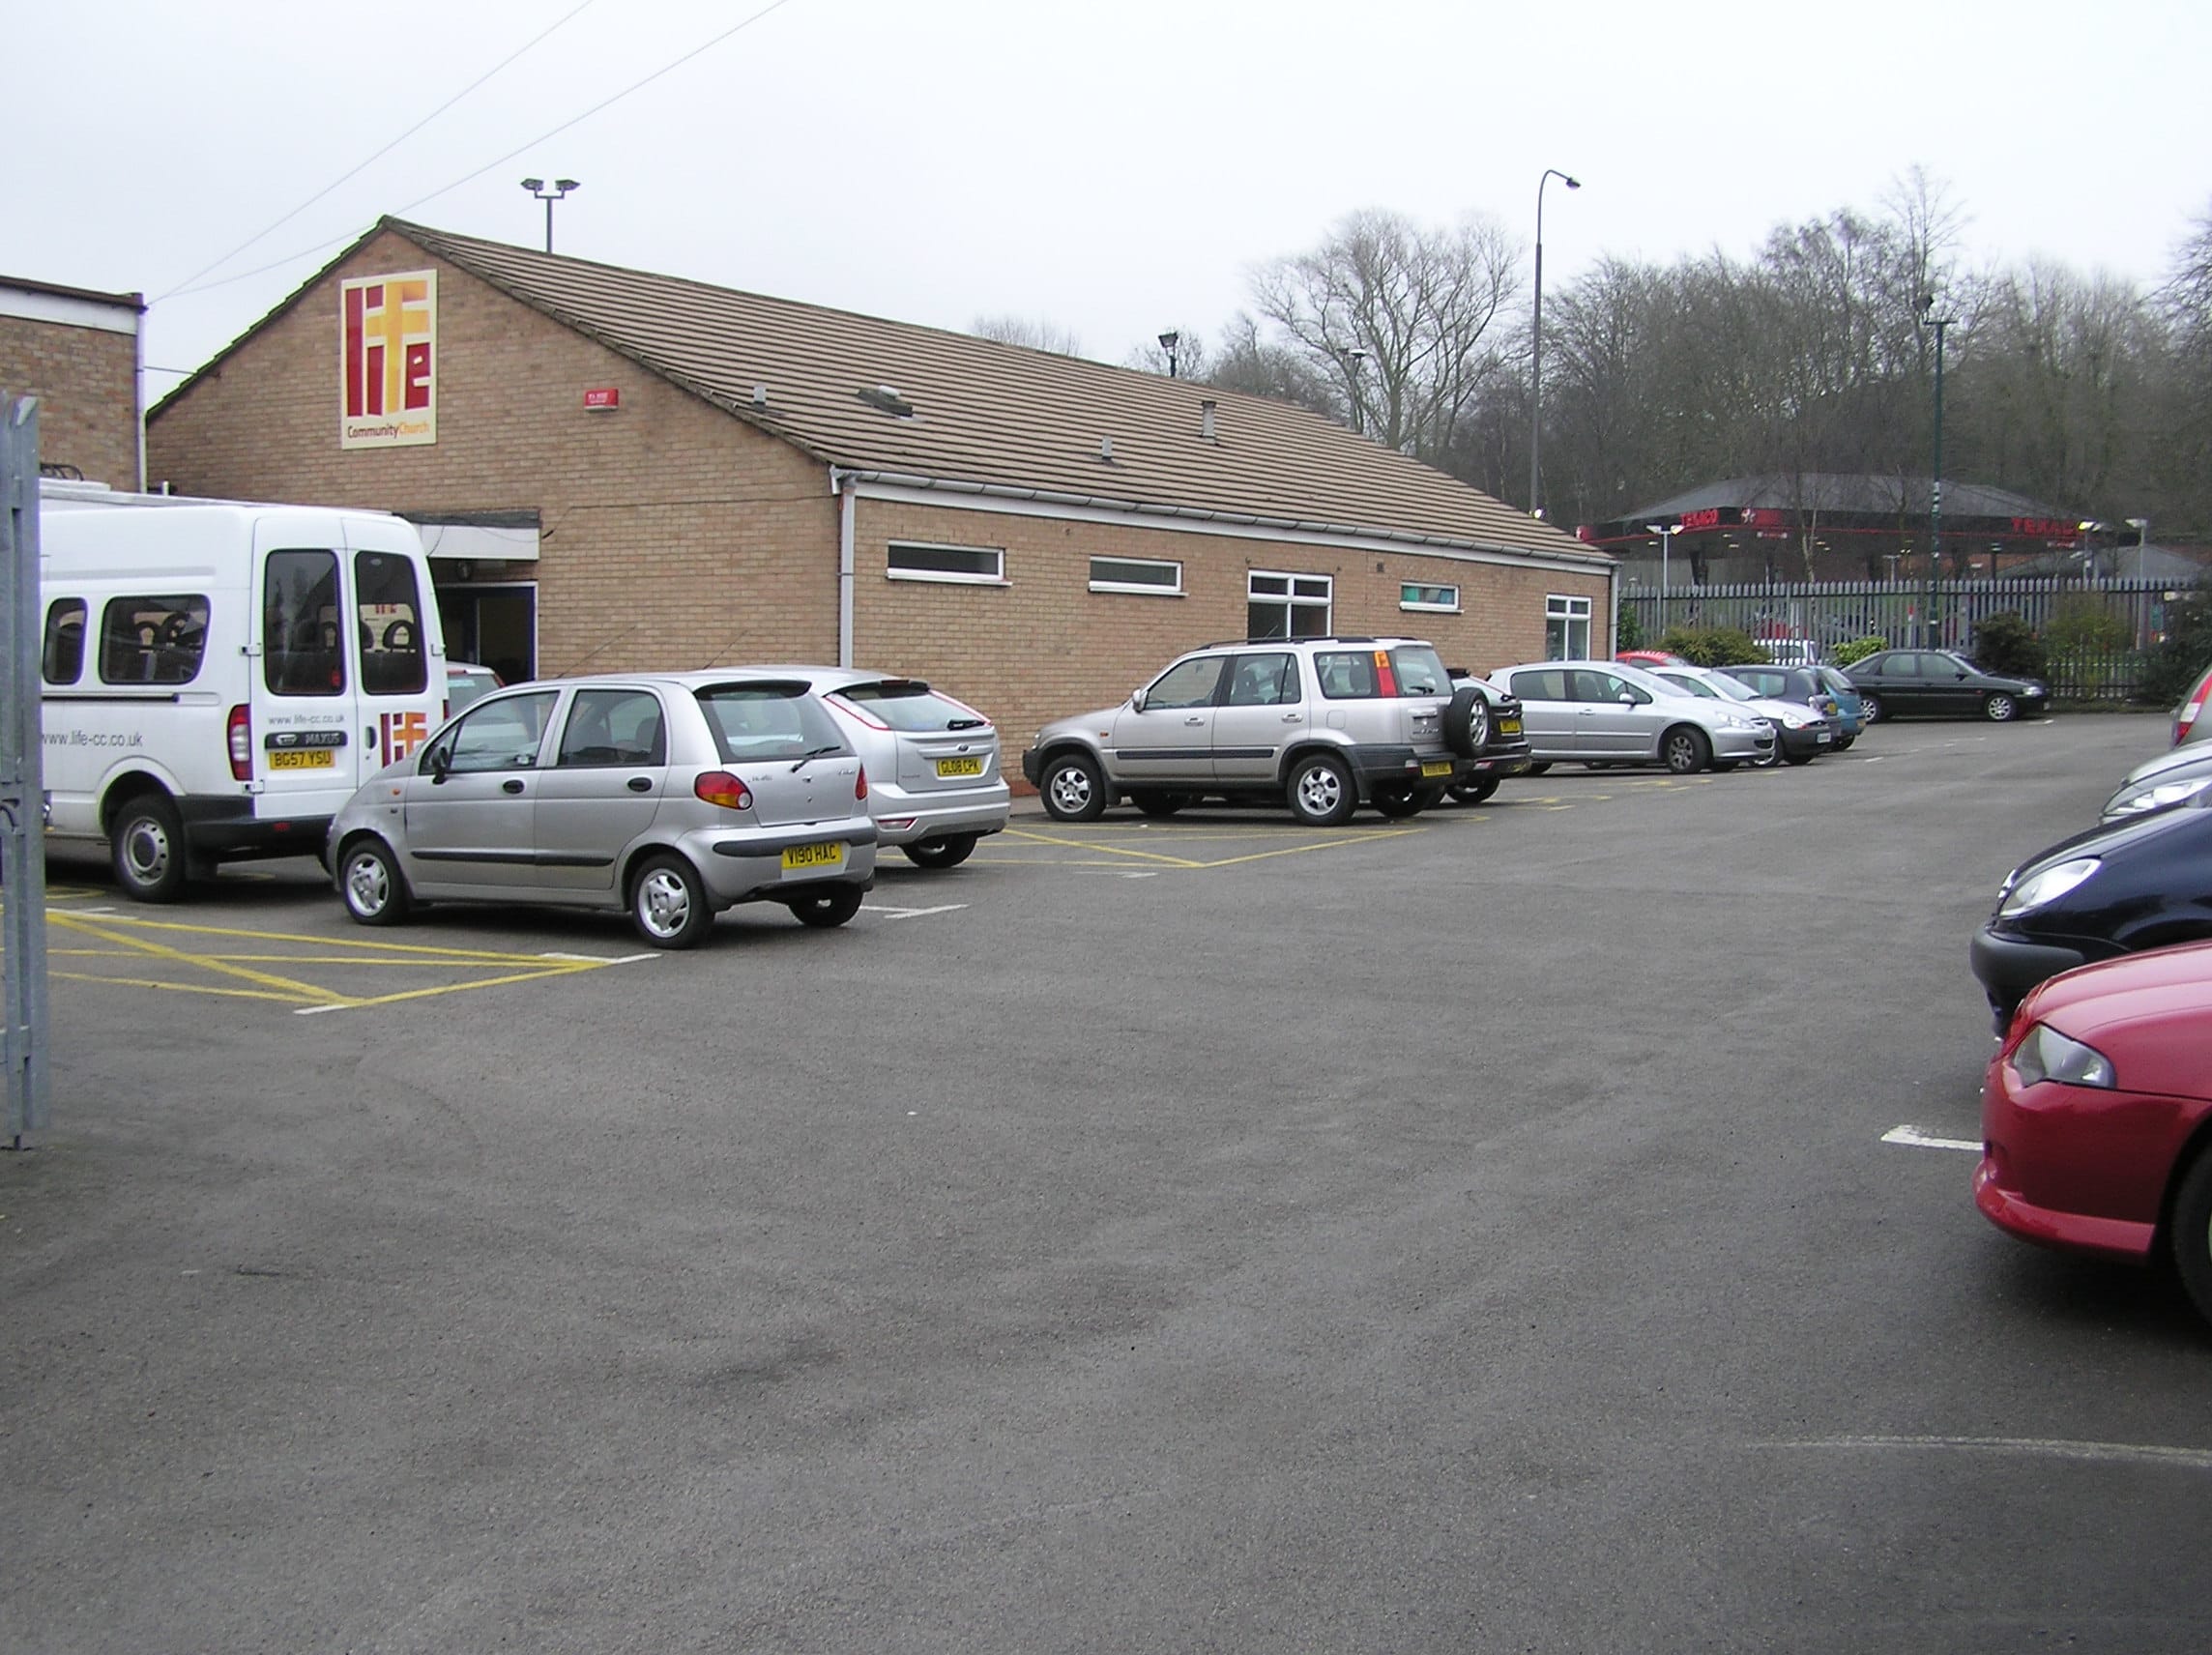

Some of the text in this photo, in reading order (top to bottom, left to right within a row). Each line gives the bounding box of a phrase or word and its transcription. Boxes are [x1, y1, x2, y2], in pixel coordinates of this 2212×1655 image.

[2012, 517, 2078, 535] TEXAC
[275, 752, 305, 766] BG57
[788, 844, 836, 864] V190 HAC
